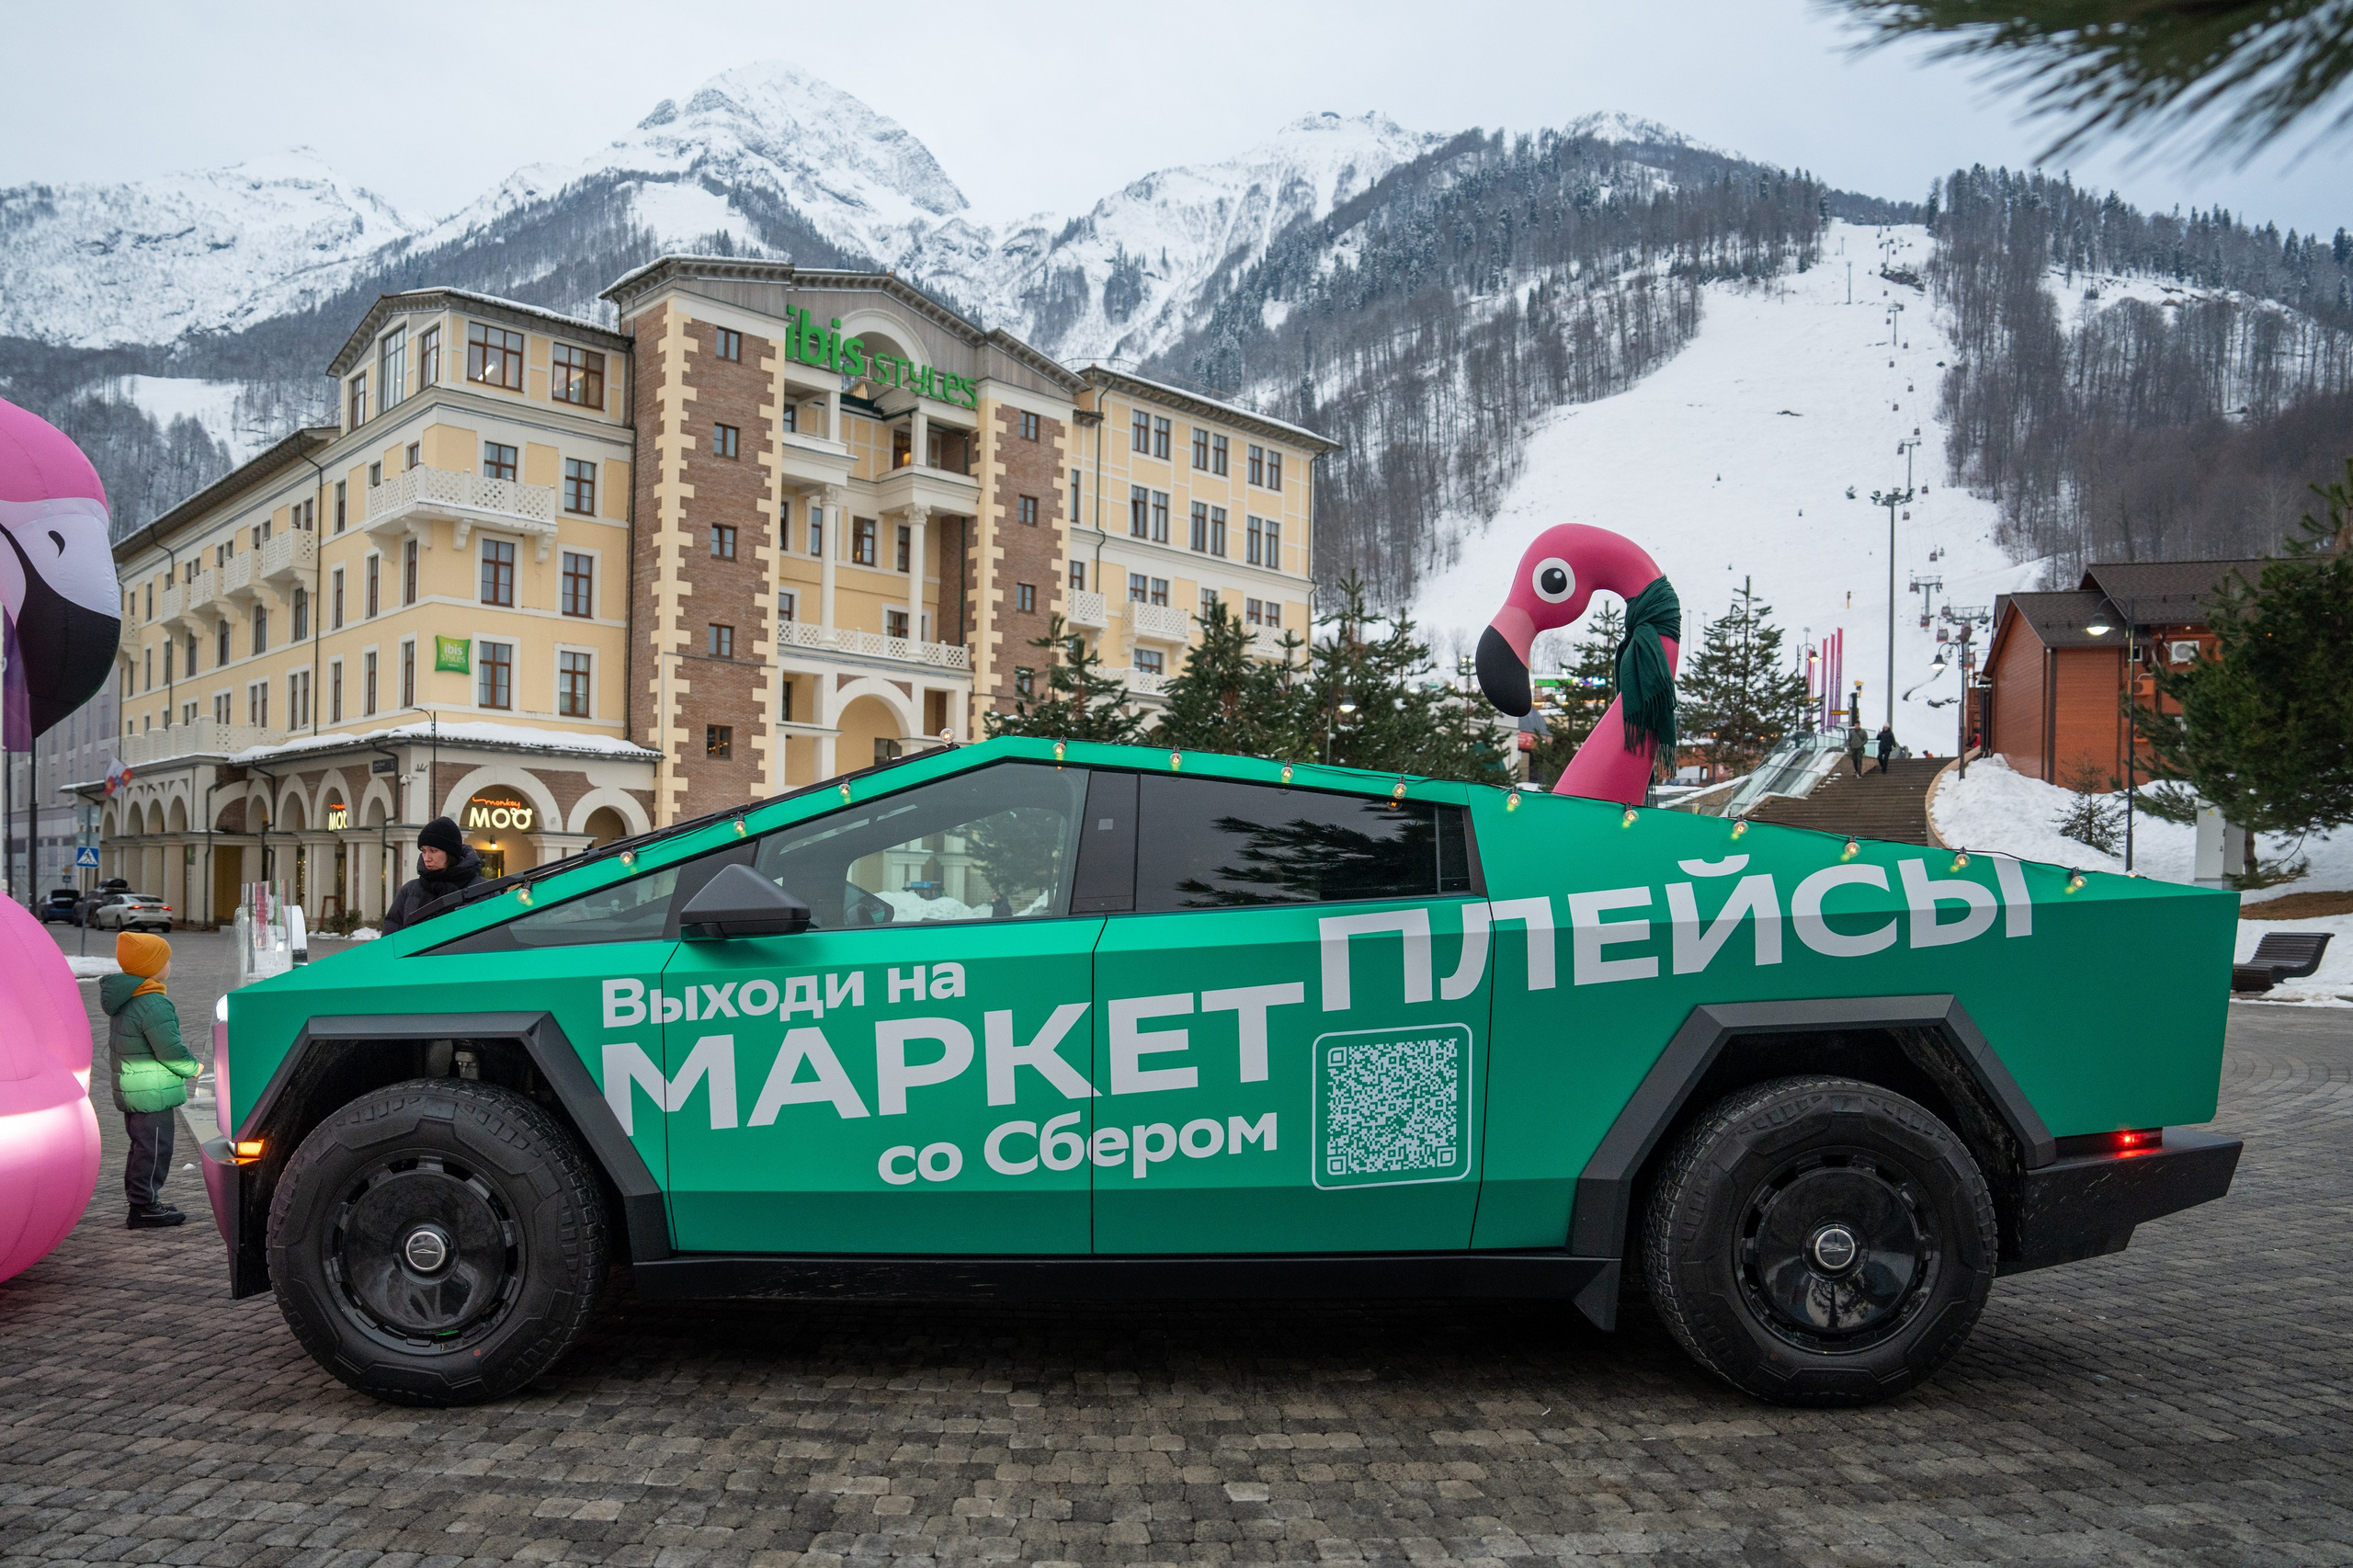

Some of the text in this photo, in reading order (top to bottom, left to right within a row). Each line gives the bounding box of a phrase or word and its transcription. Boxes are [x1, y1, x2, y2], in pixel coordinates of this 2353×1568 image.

[786, 304, 865, 376] ibis
[444, 642, 463, 655] ibis
[469, 807, 533, 830] MOO
[472, 796, 521, 811] monkey
[1318, 854, 2032, 1012] ПЛЕЙСЫ
[602, 961, 966, 1028] Выходи на
[601, 982, 1305, 1137] МАРКЕТ
[878, 1110, 1278, 1186] со Сбером
